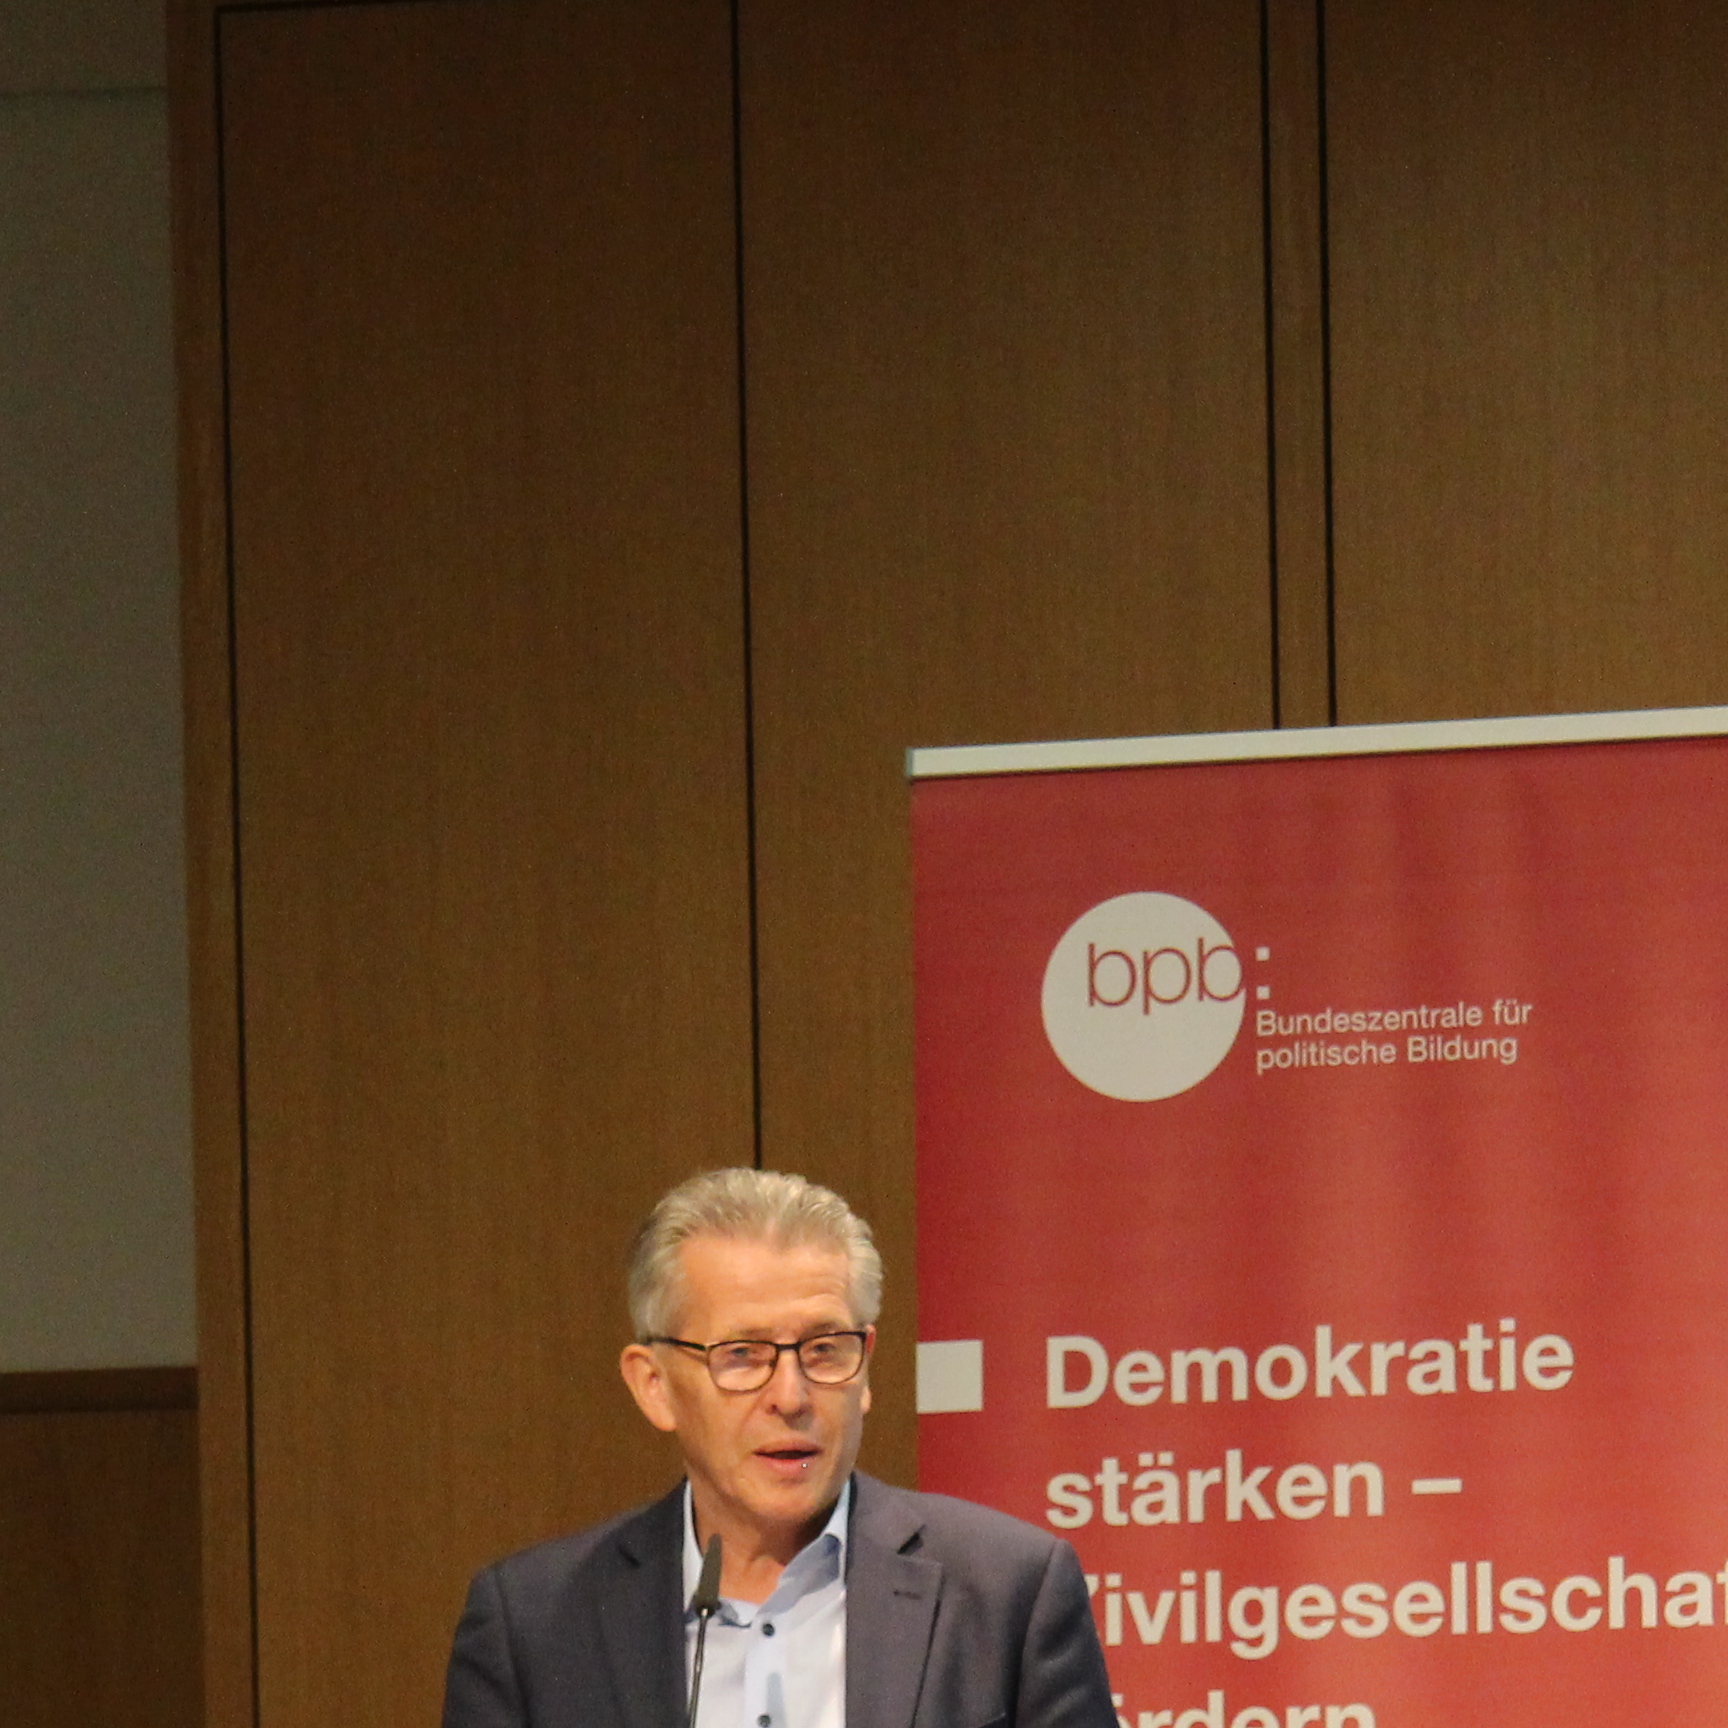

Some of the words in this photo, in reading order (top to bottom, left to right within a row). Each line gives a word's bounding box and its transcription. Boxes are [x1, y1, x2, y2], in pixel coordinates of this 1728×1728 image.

[1256, 1002, 1483, 1037] Bundeszentrale
[1492, 999, 1534, 1026] für
[1256, 1039, 1397, 1075] politische
[1406, 1034, 1519, 1065] Bildung
[1045, 1317, 1575, 1409] Demokratie
[1045, 1448, 1385, 1530] stärken
